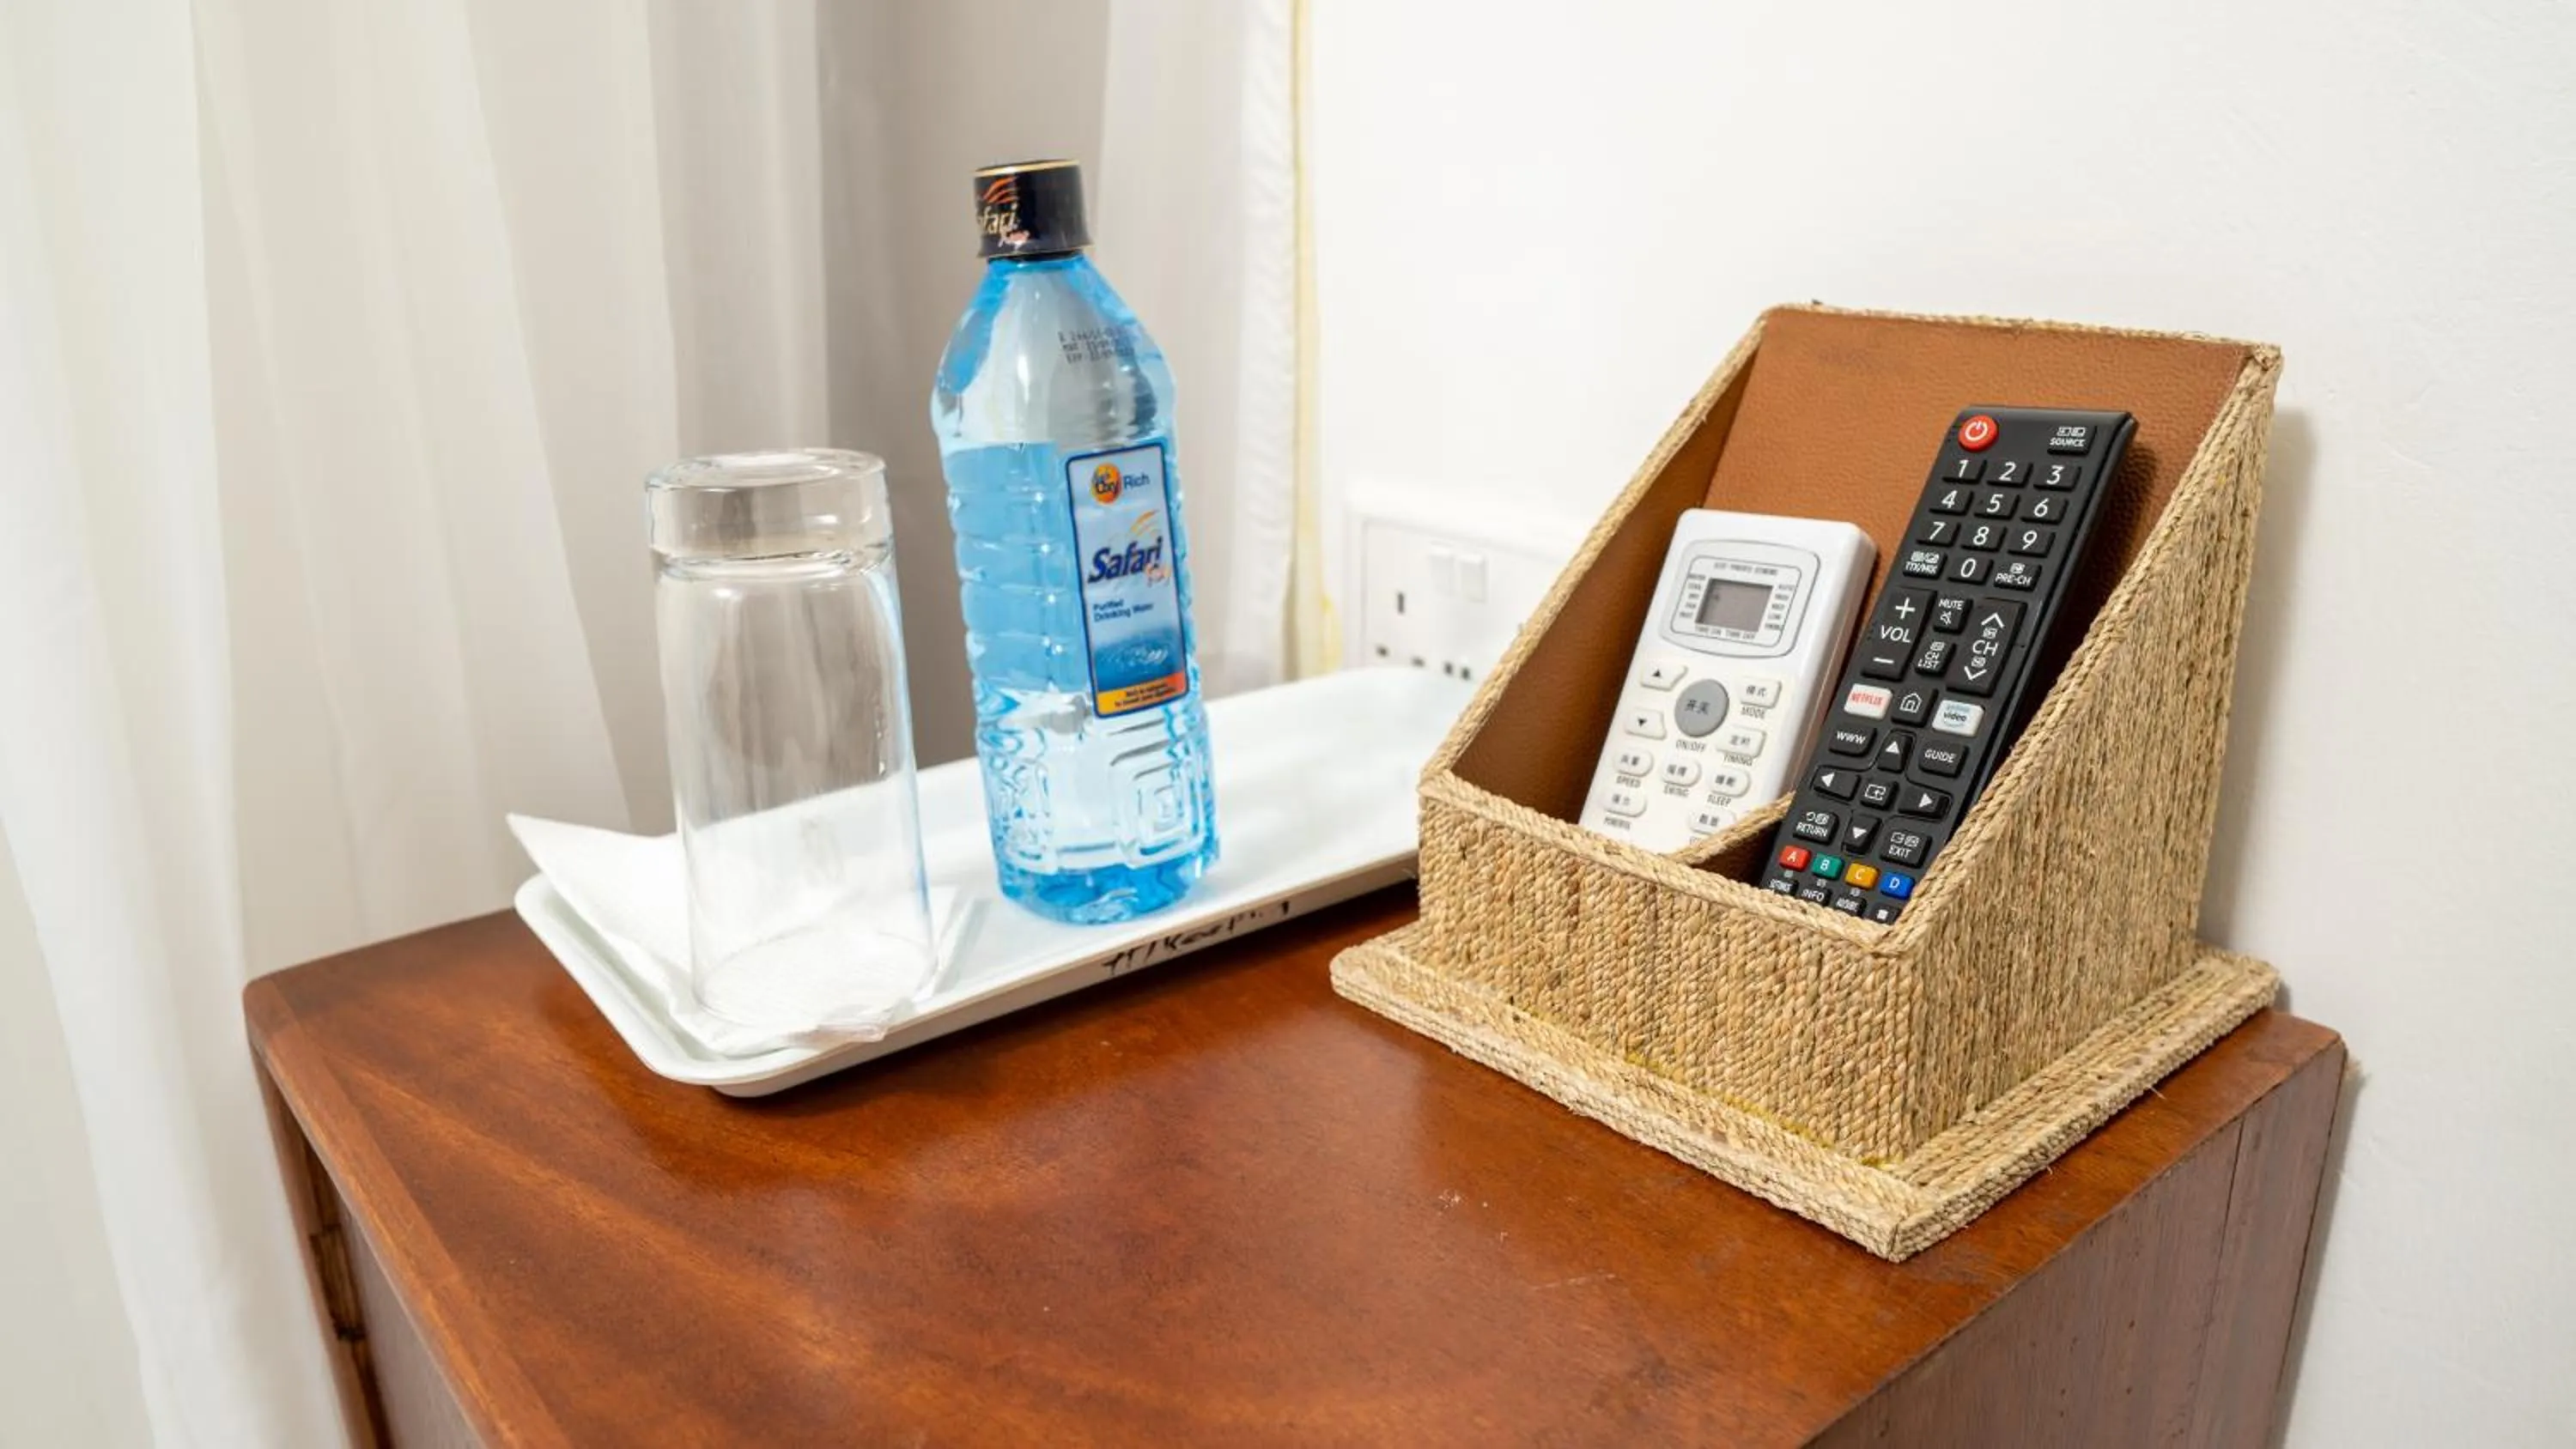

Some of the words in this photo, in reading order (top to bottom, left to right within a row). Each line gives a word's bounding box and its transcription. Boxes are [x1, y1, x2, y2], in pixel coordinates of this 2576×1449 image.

[2050, 437, 2086, 447] SOURCE
[1958, 459, 1969, 478] 1
[1999, 462, 2017, 482] 2
[2046, 464, 2063, 485] 3
[1123, 473, 1151, 489] Rich
[1941, 490, 1958, 509] 4
[1986, 494, 2003, 513] 5
[2033, 497, 2050, 518] 6
[1929, 521, 1946, 541] 7
[1972, 526, 1990, 546] 8
[2022, 530, 2038, 550] 9
[1088, 536, 1163, 584] Safari
[1904, 561, 1939, 576] TTX/MIX
[1960, 558, 1977, 579] 0
[1995, 573, 2032, 586] PRE-CH
[1938, 598, 1965, 610] MUTE
[1094, 608, 1131, 622] Drinking
[1133, 603, 1154, 613] Water
[1880, 625, 1911, 644] VOL
[1924, 652, 1940, 660] CH
[1972, 640, 1998, 657] CH
[1917, 659, 1941, 670] LIST
[1850, 691, 1884, 706] NETFLIX
[1741, 706, 1765, 720] MODE
[1943, 712, 1967, 722] video
[1675, 740, 1706, 753] ON/OFF
[1924, 749, 1957, 764] GUIDE
[1616, 775, 1641, 788] SPEED
[1707, 794, 1732, 807] SLEEP
[1795, 822, 1828, 838] RETURN
[1888, 846, 1912, 858] EXIT
[1787, 851, 1797, 863] A
[1820, 859, 1830, 870] B
[1855, 868, 1864, 881] C
[1889, 877, 1900, 889] D
